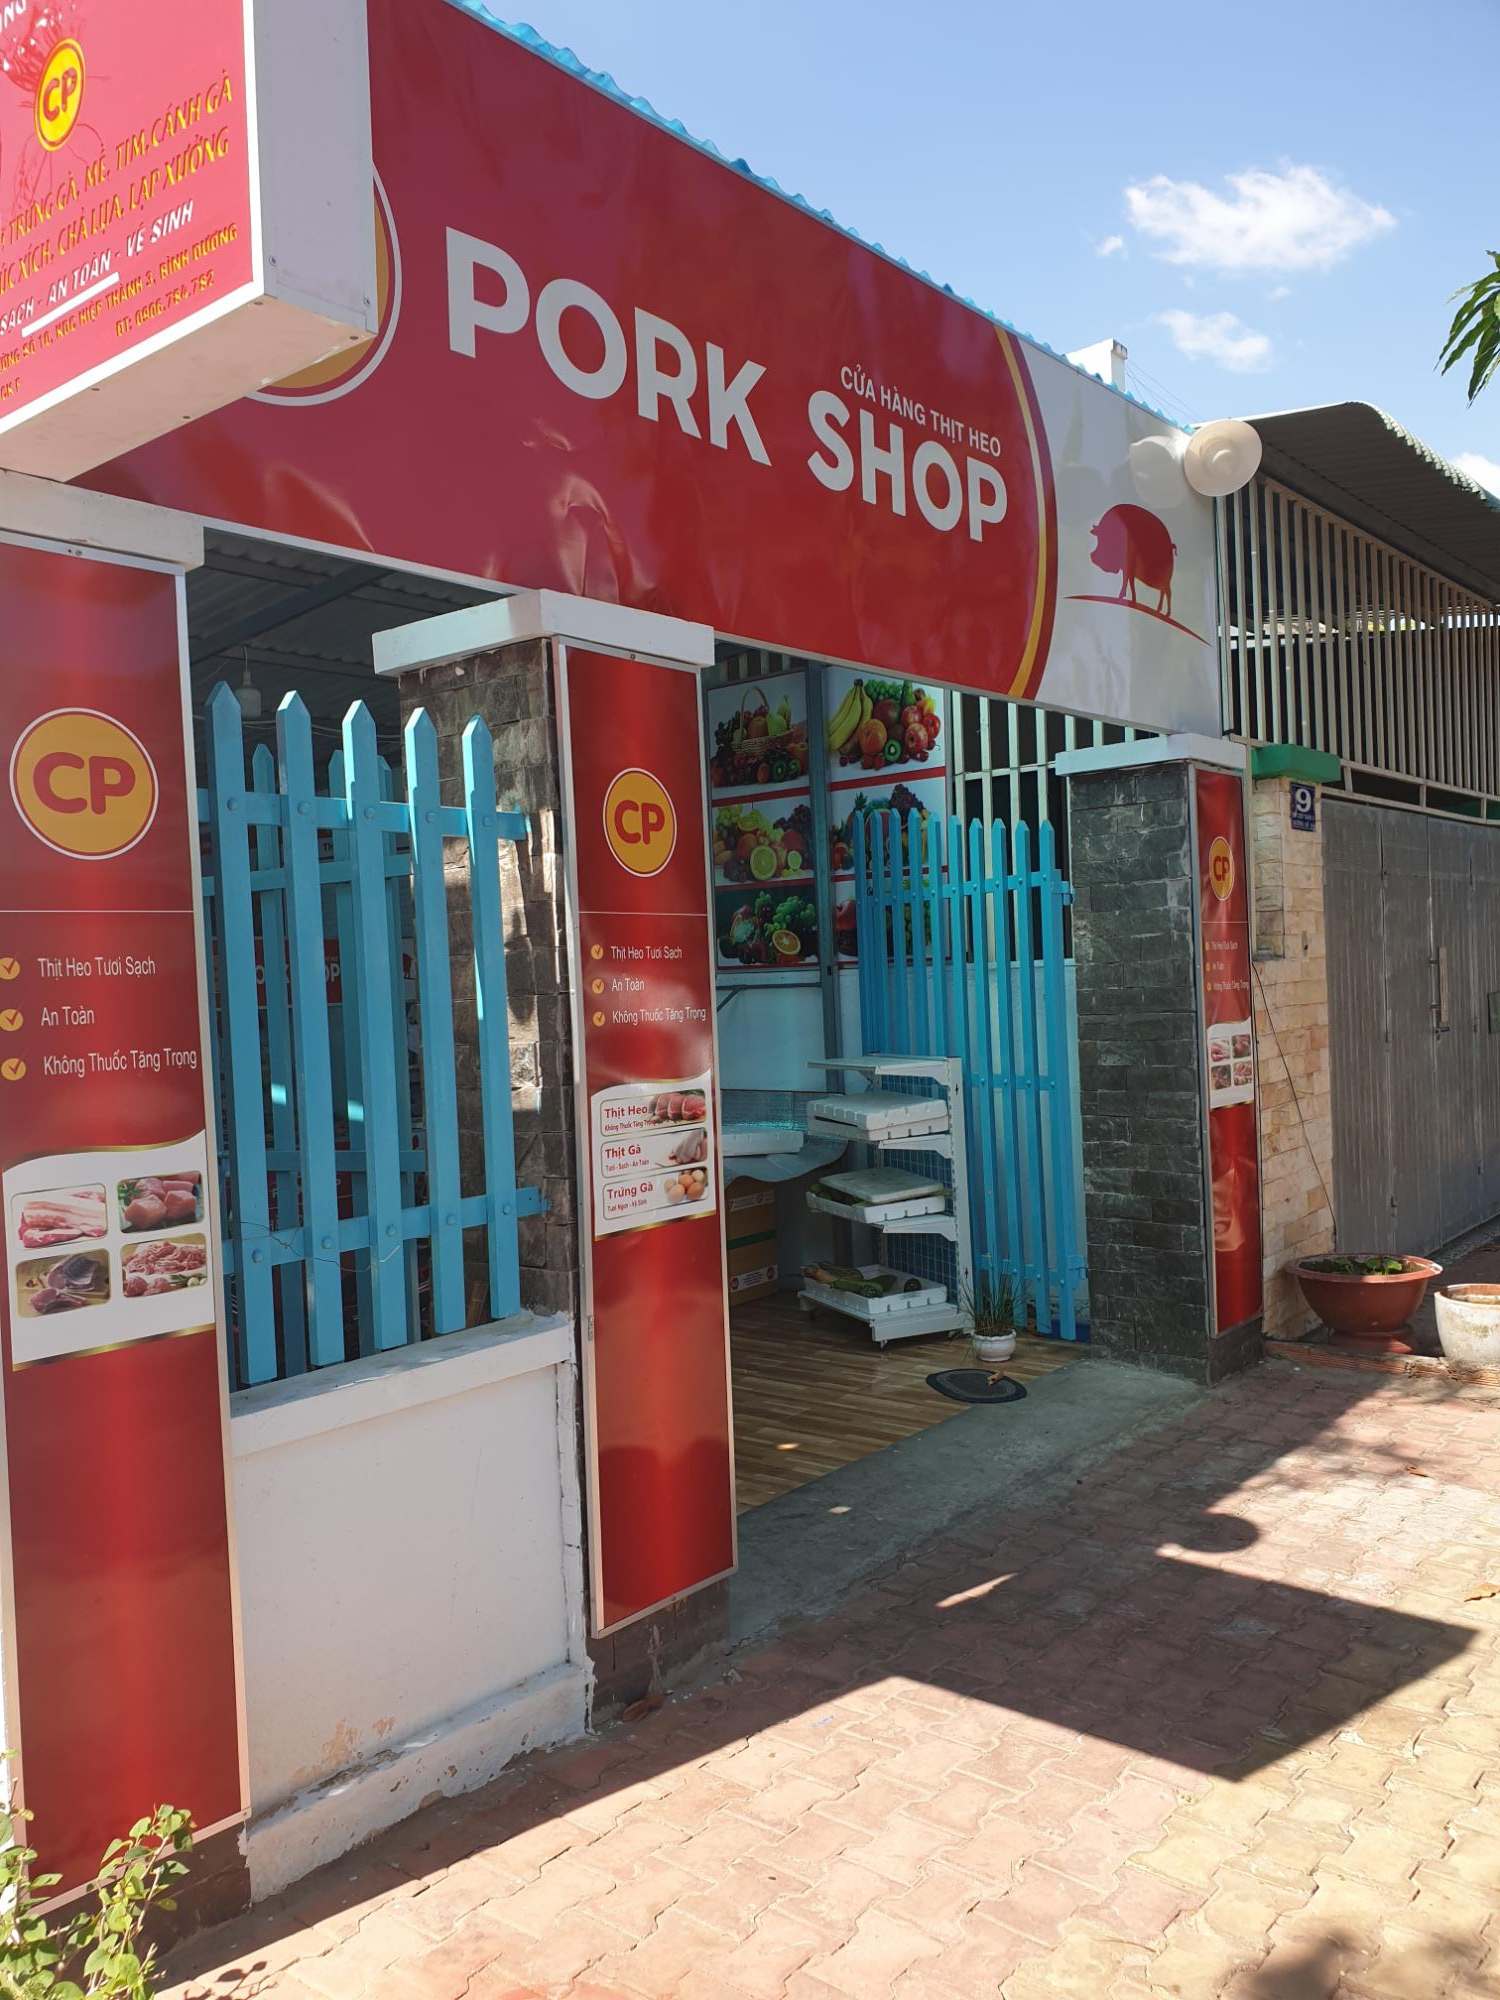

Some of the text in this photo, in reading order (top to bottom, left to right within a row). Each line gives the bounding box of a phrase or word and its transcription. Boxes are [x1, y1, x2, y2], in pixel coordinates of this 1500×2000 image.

[43, 67, 77, 121] CP
[151, 92, 201, 148] CÁNH
[205, 69, 232, 114] GÀ
[0, 261, 16, 296] ÚC
[130, 168, 160, 211] LẠP
[46, 274, 68, 307] AN
[72, 247, 112, 292] TOÀN
[149, 198, 194, 244] SINH
[446, 226, 1007, 542] PORK SHOP
[841, 364, 1001, 457] CỬA HÀNG THỊT HEO
[33, 751, 136, 815] CP
[1295, 788, 1311, 813] 9
[614, 800, 665, 845] CP
[1213, 855, 1230, 881] CP
[611, 945, 626, 961] Thịt
[628, 945, 644, 959] Heo
[37, 955, 156, 981] Thịt Heo Tươi Sạch
[612, 977, 645, 992] An Toàn
[41, 1005, 95, 1026] An Toàn
[612, 1009, 638, 1026] Không
[43, 1054, 85, 1079] Không
[88, 1049, 127, 1072] Thuốc
[163, 1047, 197, 1069] Trọng
[604, 1105, 648, 1119] Thịt Heo
[604, 1144, 641, 1159] Thịt Gà
[606, 1181, 653, 1200] Trứng Gà
